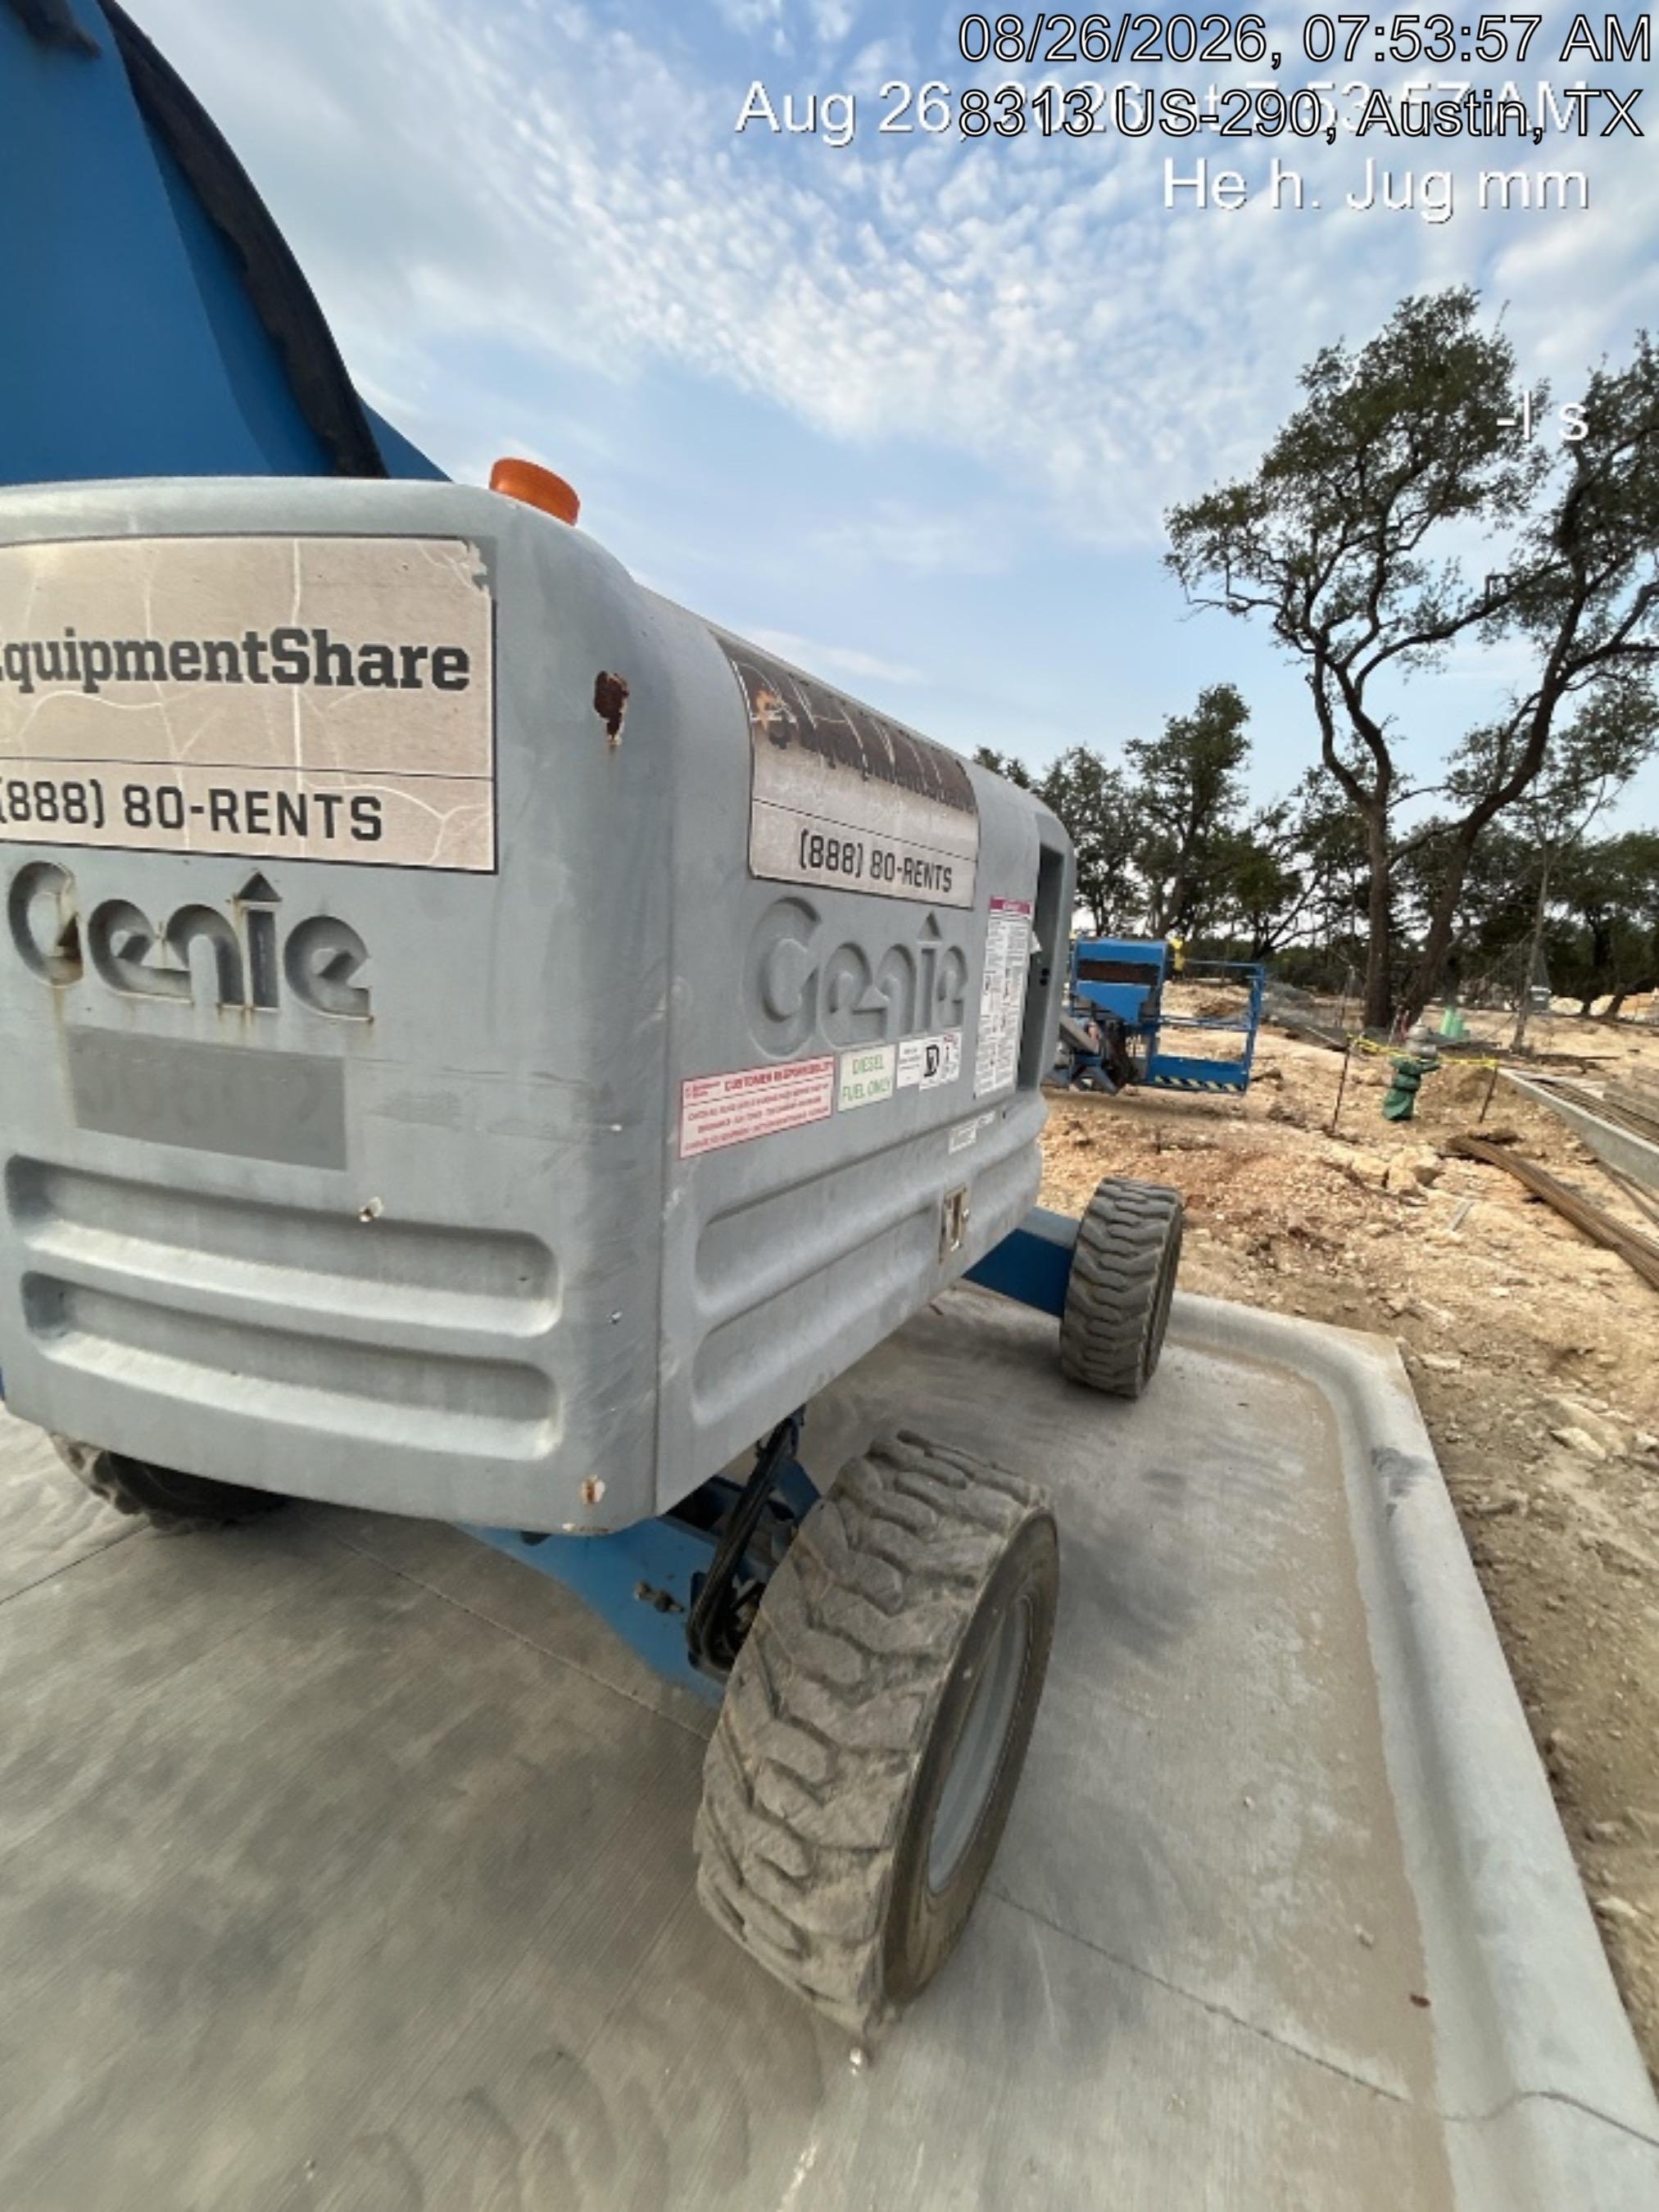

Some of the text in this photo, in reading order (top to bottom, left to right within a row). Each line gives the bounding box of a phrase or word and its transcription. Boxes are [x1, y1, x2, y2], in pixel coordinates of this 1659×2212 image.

[0, 627, 470, 692] quipmentShare
[123, 784, 383, 841] 80-RENTS
[800, 827, 953, 893] (888) 80-RENTS
[8, 859, 374, 1022] Genie
[743, 896, 970, 1058] Genie
[842, 1082, 866, 1101] FUEL
[852, 1054, 885, 1075] DIESEL
